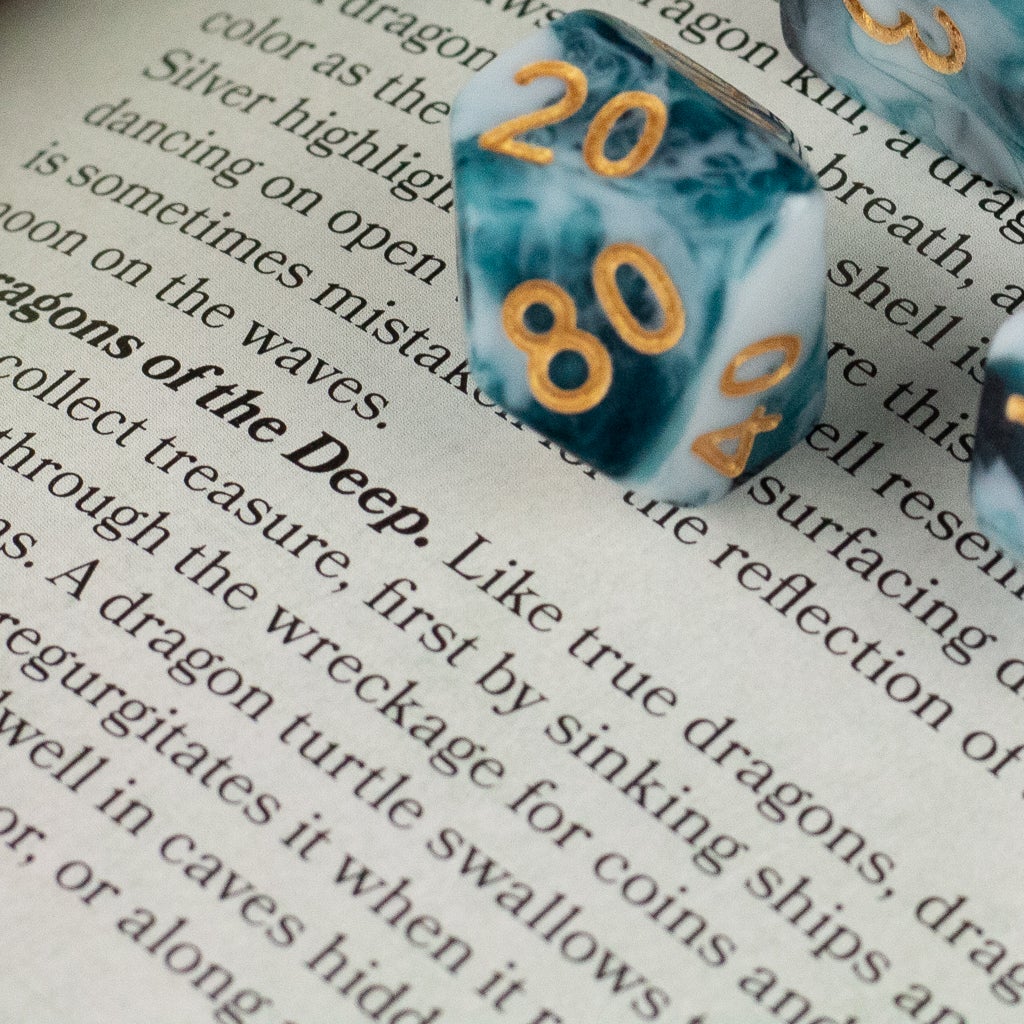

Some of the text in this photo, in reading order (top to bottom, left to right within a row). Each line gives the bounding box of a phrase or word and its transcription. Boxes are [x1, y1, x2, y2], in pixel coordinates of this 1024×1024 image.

[141, 47, 277, 116] Silver
[272, 97, 456, 214] highligh
[479, 60, 669, 178] 20
[200, 9, 974, 465] color as the this
[815, 152, 978, 292] breath,
[828, 257, 962, 351] shell
[83, 97, 265, 190] dancing
[260, 176, 323, 217] on
[327, 209, 447, 287] open
[744, 473, 998, 667] surfacing
[90, 247, 153, 288] on
[155, 272, 236, 329] the
[241, 319, 388, 431] waves.
[502, 242, 686, 415] 80
[20, 141, 69, 176] is
[65, 163, 313, 289] sometimes
[708, 534, 960, 733] reflection
[0, 272, 146, 360] agons
[141, 353, 225, 392] of
[194, 379, 289, 444] the
[280, 430, 432, 547] Deep.
[442, 531, 565, 633] Like
[568, 624, 681, 719] true
[683, 716, 899, 901] dragons,
[45, 558, 672, 1023] A dragon turtle swallows
[143, 433, 352, 594] treasure,
[363, 576, 481, 669] first
[474, 651, 549, 717] by
[543, 712, 751, 877] sinking
[743, 861, 893, 986] ships
[173, 543, 738, 969] the wreckage for coins
[55, 859, 275, 1024] or along
[94, 776, 156, 837] in
[158, 832, 306, 949] caves
[279, 810, 332, 862] it
[332, 852, 474, 976] when
[474, 960, 528, 1013] it
